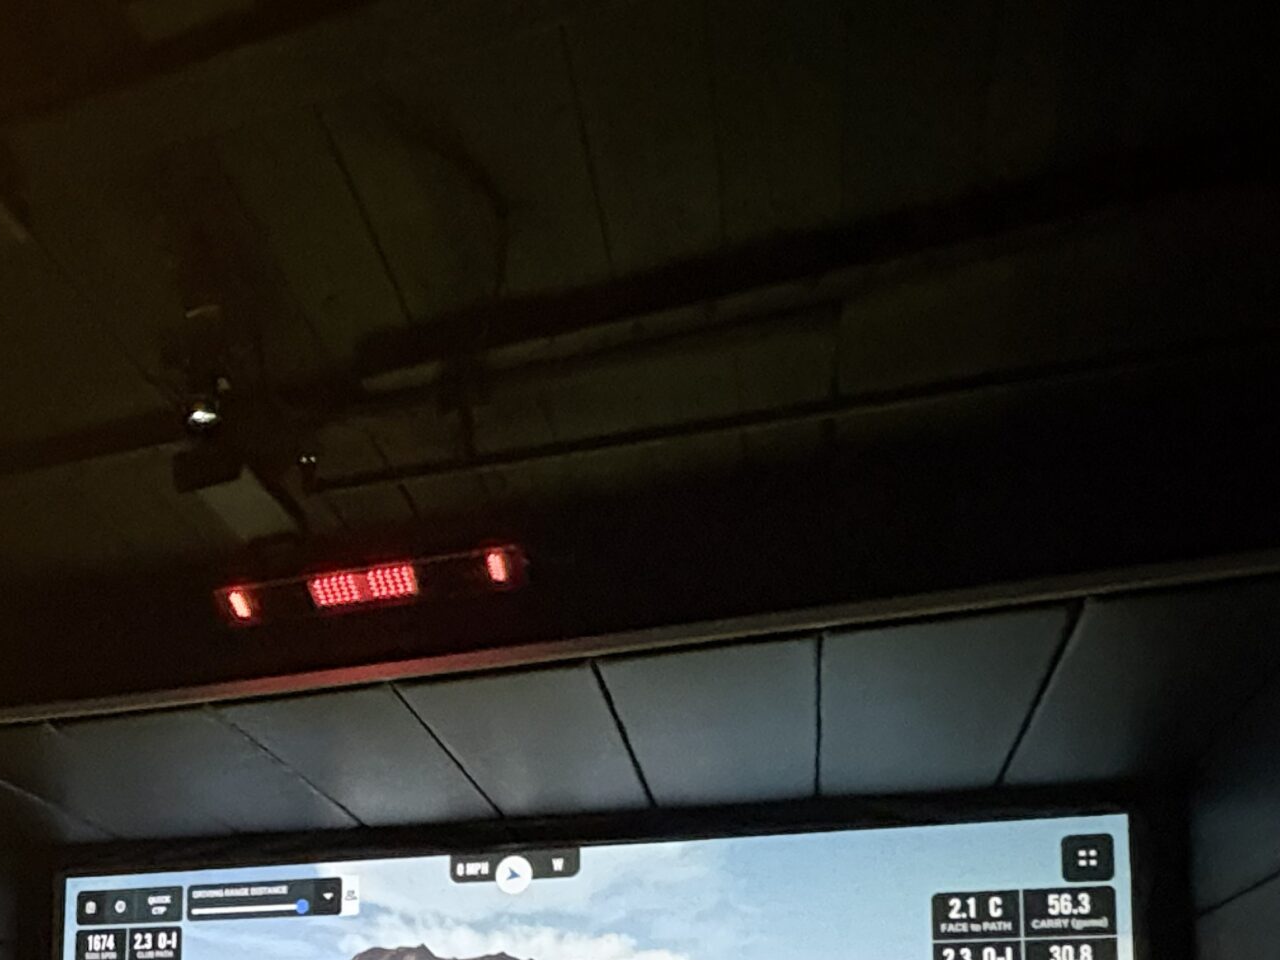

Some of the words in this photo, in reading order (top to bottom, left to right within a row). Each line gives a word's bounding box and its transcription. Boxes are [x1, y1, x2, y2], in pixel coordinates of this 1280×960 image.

[552, 858, 564, 871] W
[948, 897, 976, 919] 2.1
[988, 897, 1003, 917] C
[1047, 893, 1091, 915] 56.3
[940, 923, 967, 933] FACE
[983, 921, 1012, 931] PATH
[1031, 919, 1069, 929] CARRY
[87, 934, 115, 951] 1674
[133, 932, 153, 950] 2.3
